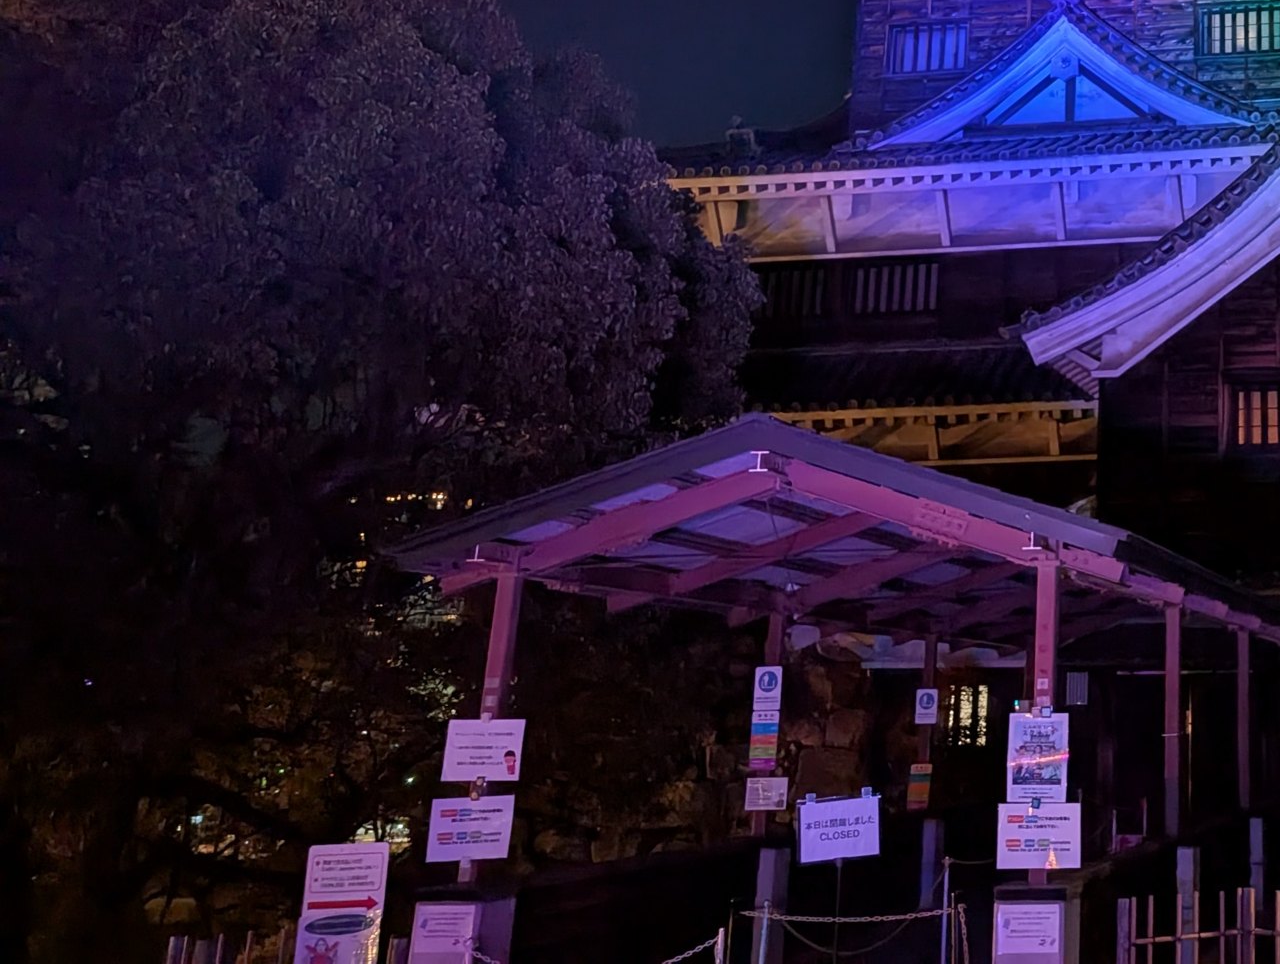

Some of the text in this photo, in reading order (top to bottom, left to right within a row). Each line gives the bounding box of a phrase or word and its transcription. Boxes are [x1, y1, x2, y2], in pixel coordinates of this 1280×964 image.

[804, 815, 876, 830] 本日は閉館しました
[819, 829, 860, 842] CLOSED
